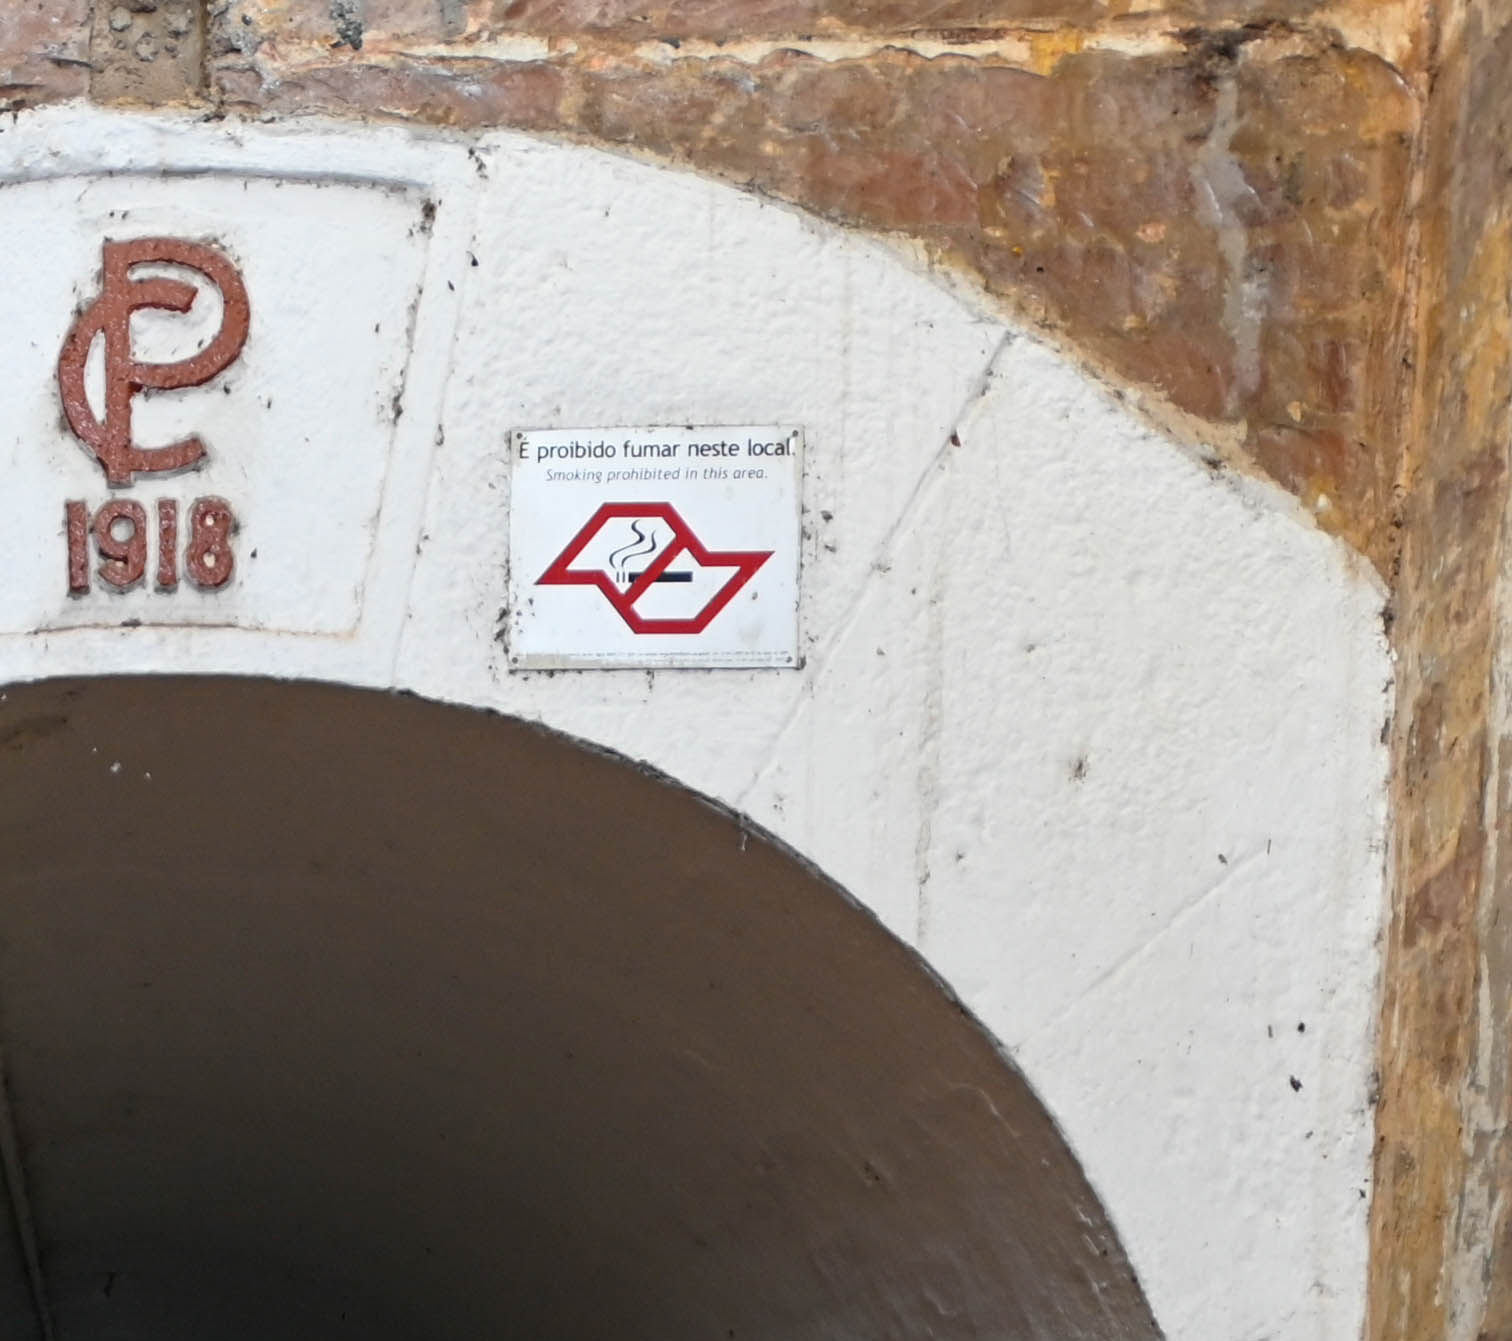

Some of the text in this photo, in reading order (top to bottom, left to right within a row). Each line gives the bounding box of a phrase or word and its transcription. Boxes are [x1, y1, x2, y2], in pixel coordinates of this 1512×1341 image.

[519, 435, 797, 463] É proibido fumar neste local.
[545, 466, 769, 484] Smoking prohibited in this area.
[64, 497, 237, 595] 1918
